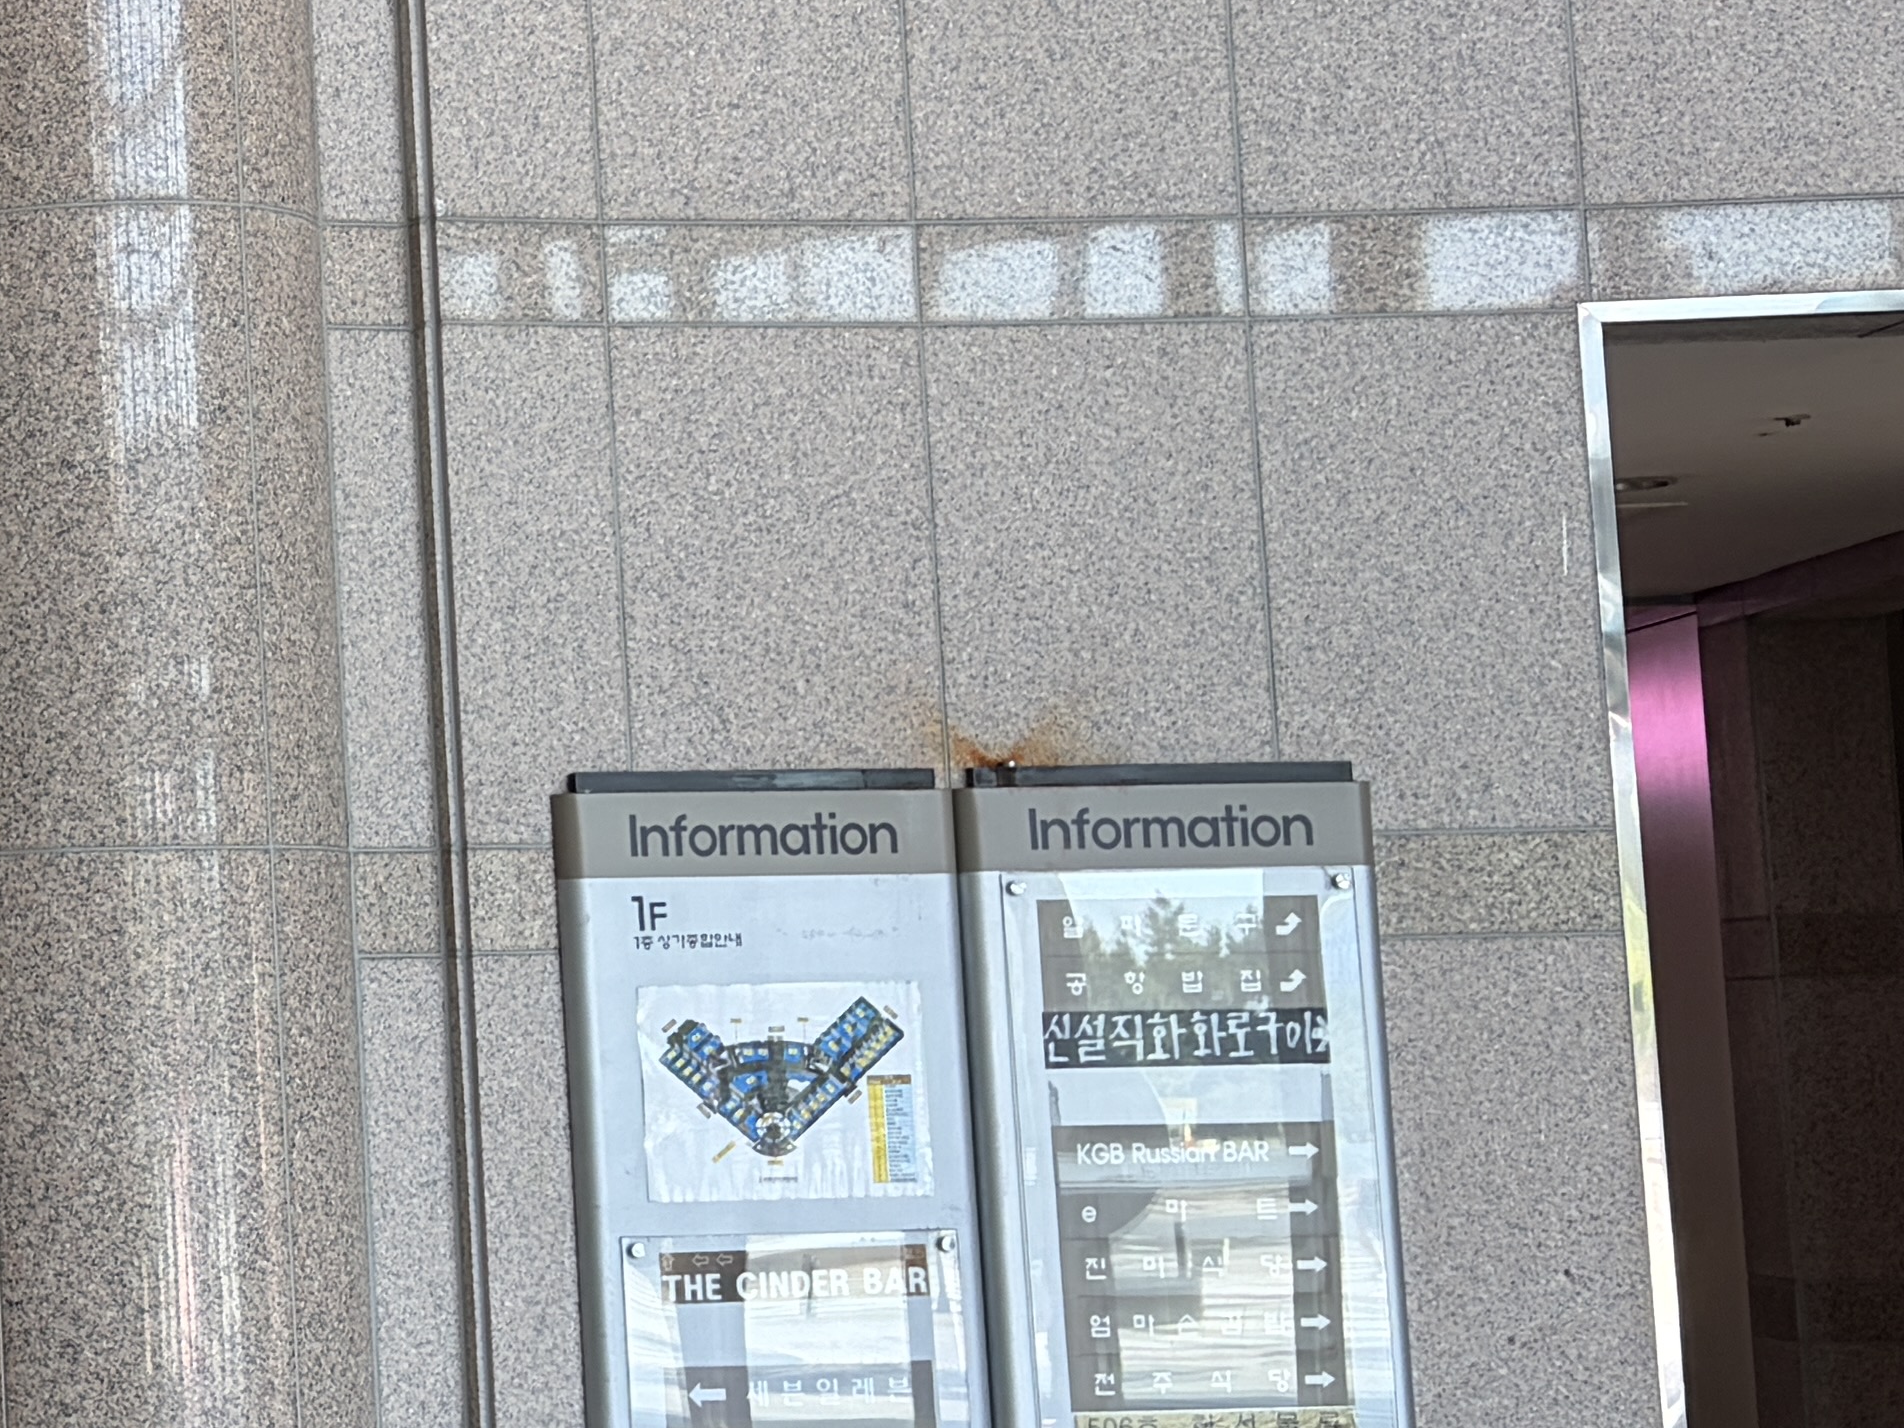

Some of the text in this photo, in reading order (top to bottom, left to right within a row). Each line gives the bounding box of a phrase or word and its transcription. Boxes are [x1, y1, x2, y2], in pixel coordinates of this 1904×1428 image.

[629, 811, 900, 859] Information
[1028, 804, 1315, 851] Information
[631, 895, 668, 932] 1F
[1044, 1011, 1313, 1065] 신설직화 화로구이
[1076, 1140, 1270, 1165] KGB Russian BAR
[661, 1267, 928, 1301] THE CINDER BAR
